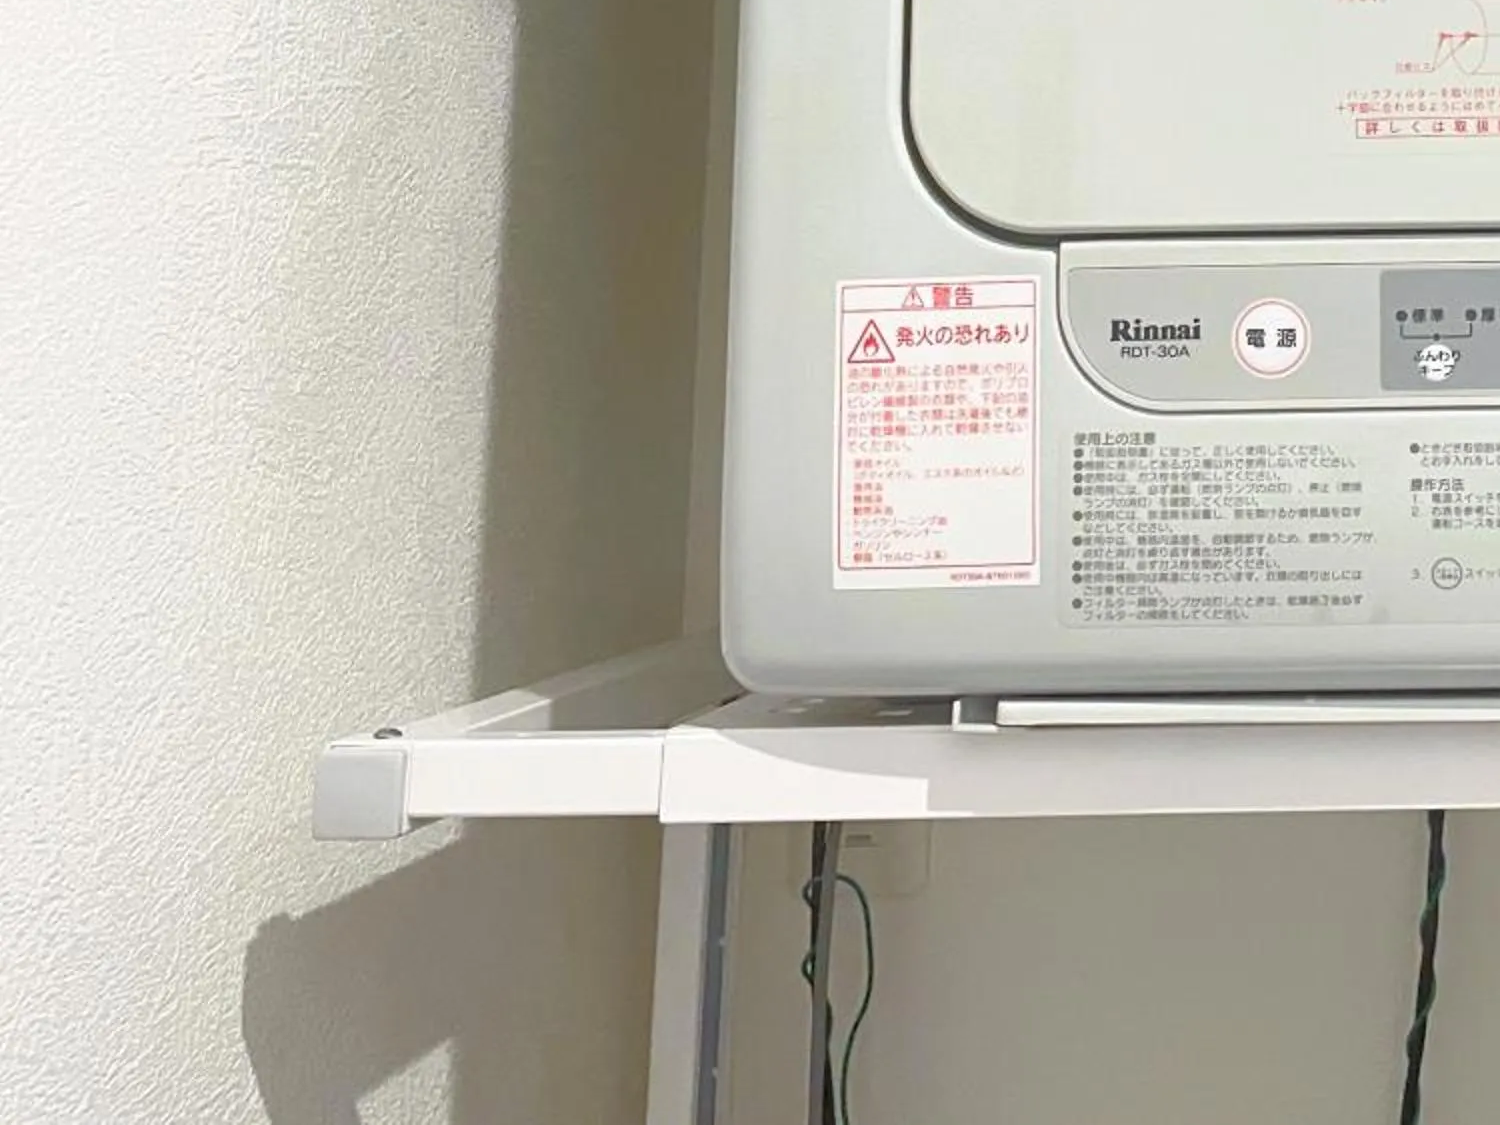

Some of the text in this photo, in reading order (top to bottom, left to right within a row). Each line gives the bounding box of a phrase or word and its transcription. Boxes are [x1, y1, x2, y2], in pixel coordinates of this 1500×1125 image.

[932, 284, 974, 309] 警告
[1411, 307, 1444, 324] 標準
[896, 322, 1029, 348] 発火の恐れあり
[1110, 318, 1201, 342] Rinnai
[1245, 328, 1298, 348] 電源
[1121, 346, 1190, 358] RDT-30A
